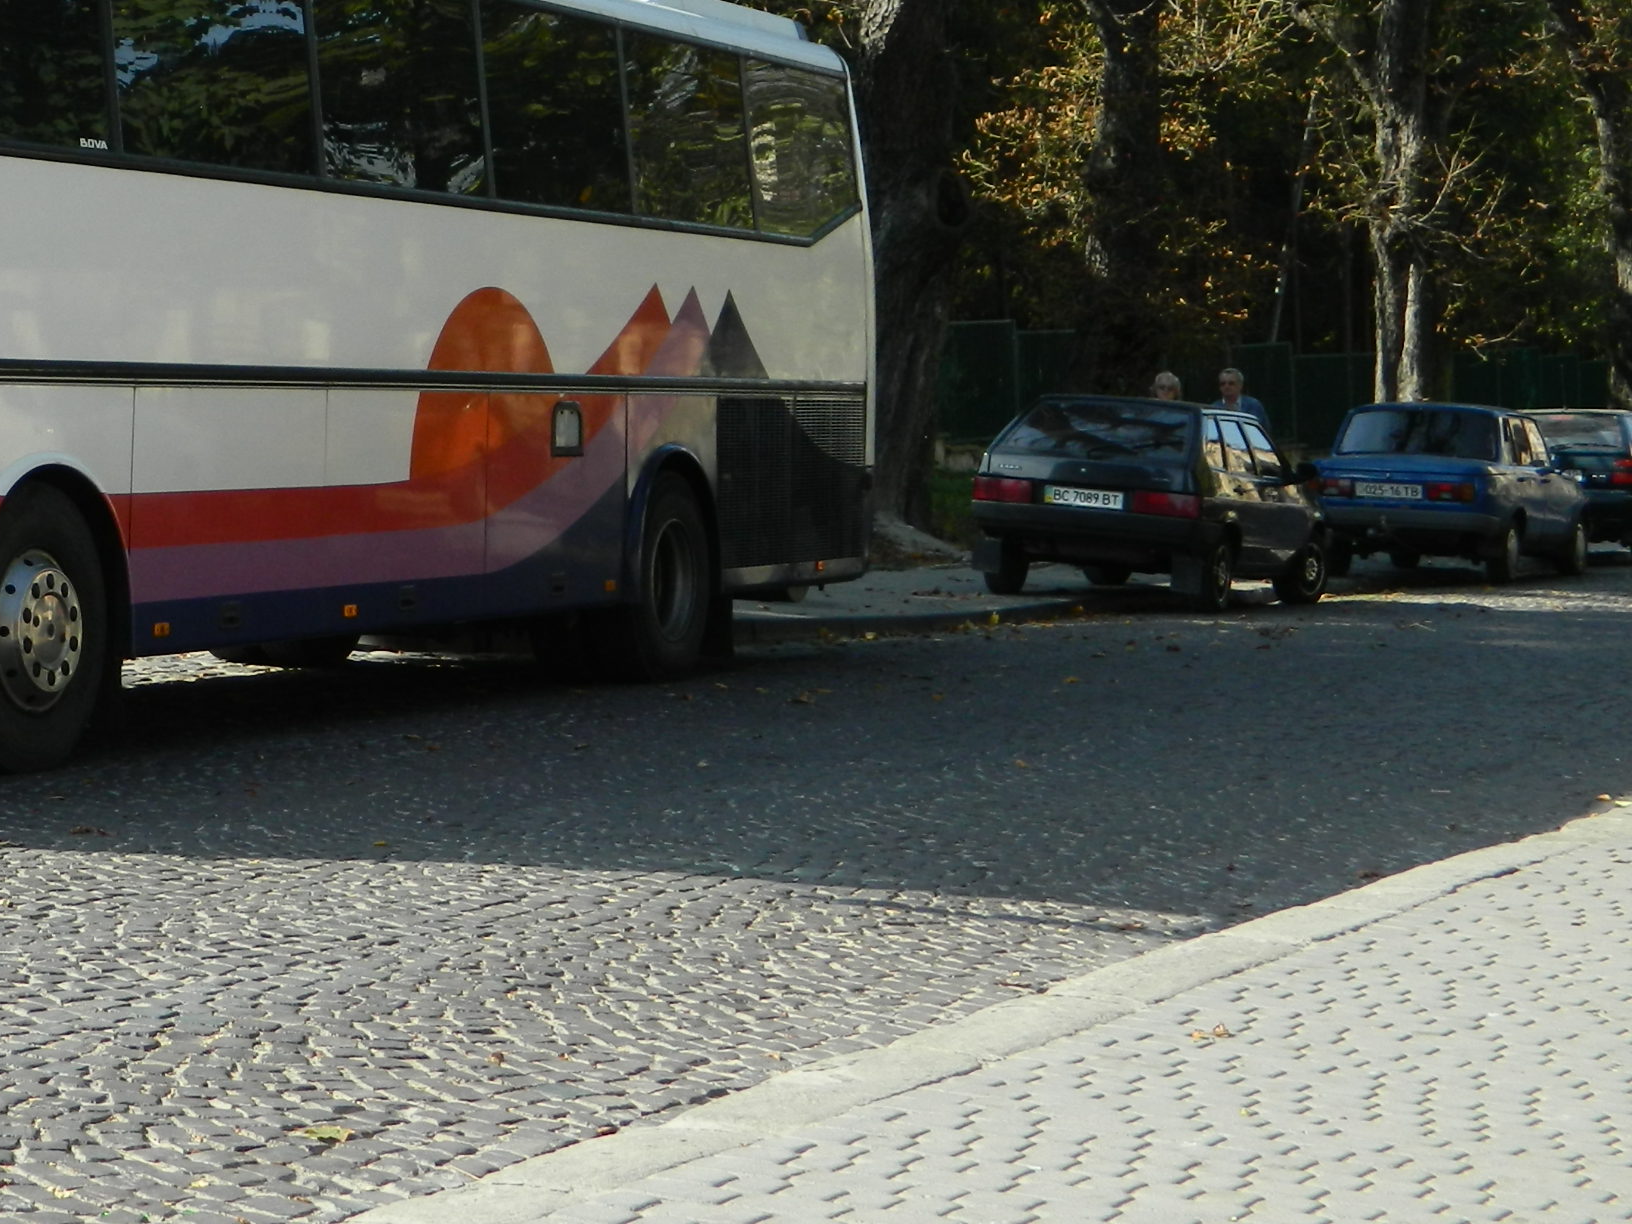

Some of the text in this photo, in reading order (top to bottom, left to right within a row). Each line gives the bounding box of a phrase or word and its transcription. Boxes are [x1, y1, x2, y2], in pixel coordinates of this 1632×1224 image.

[79, 137, 108, 150] BOVA
[1053, 489, 1120, 506] BC 7089 BT
